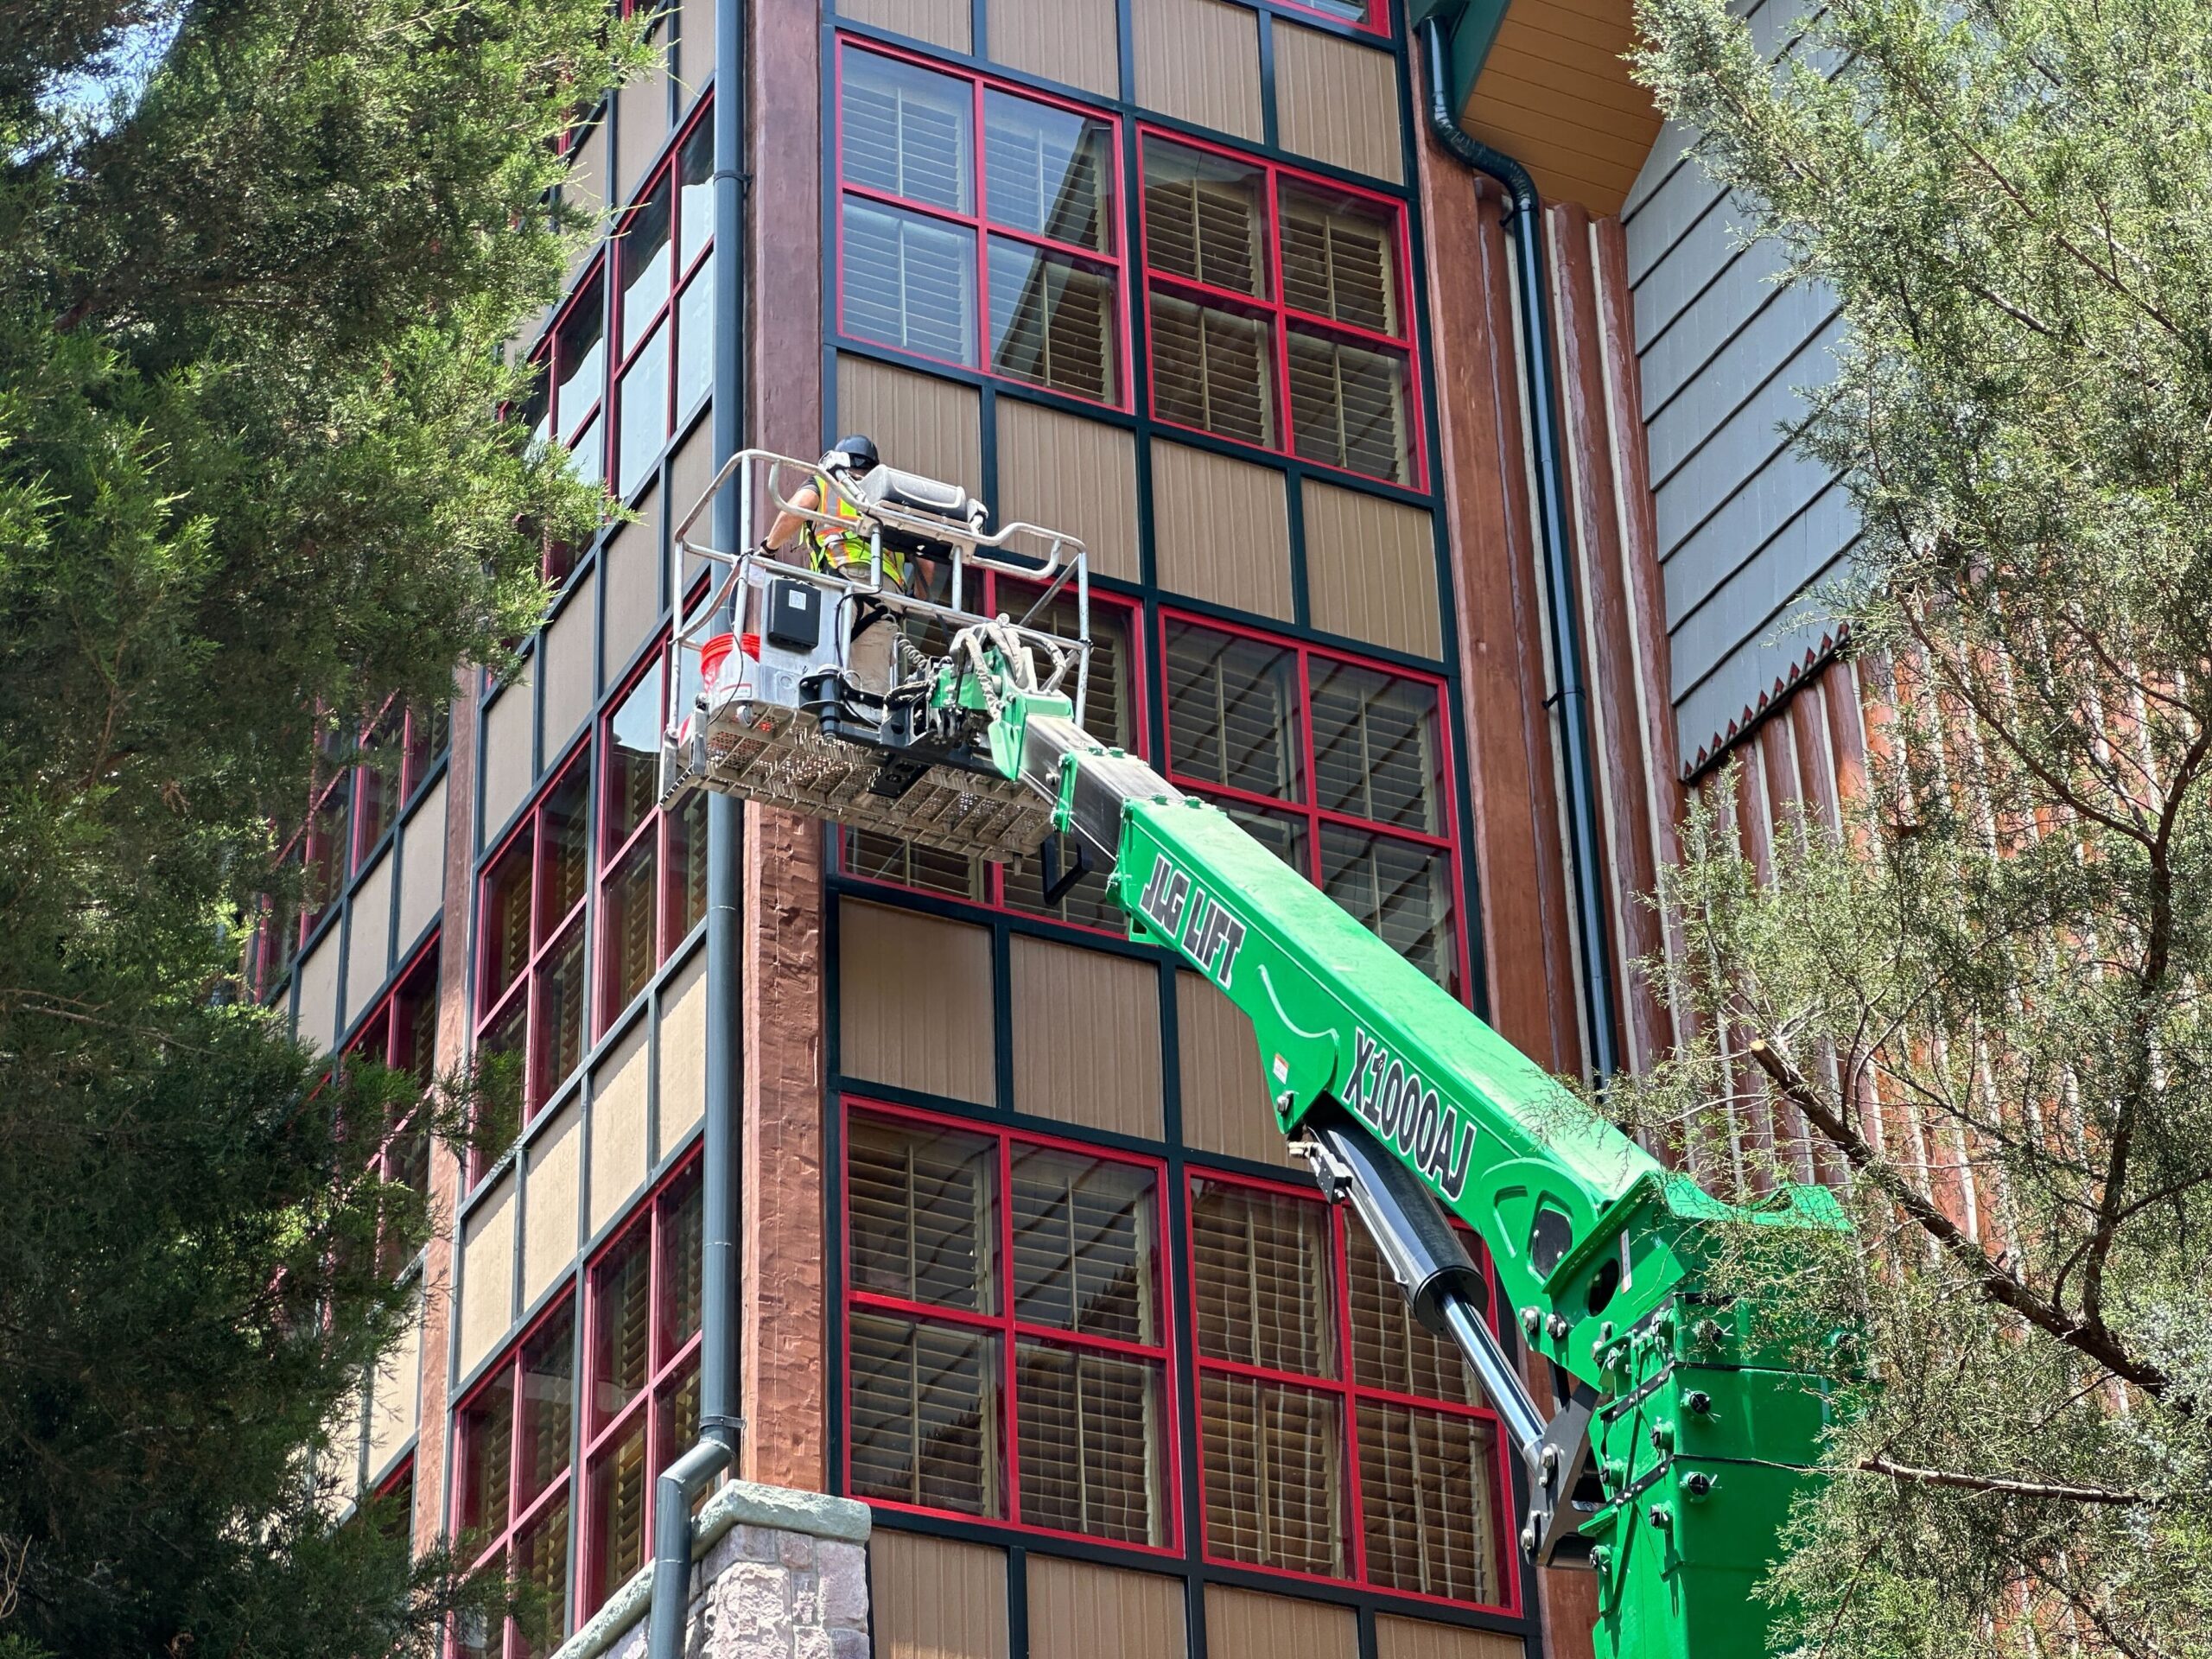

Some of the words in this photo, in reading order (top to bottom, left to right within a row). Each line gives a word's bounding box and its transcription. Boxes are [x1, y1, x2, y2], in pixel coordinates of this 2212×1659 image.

[1139, 852, 1192, 939] JLG
[1181, 887, 1247, 990] LIFT
[1341, 1026, 1478, 1202] X1000AJ
